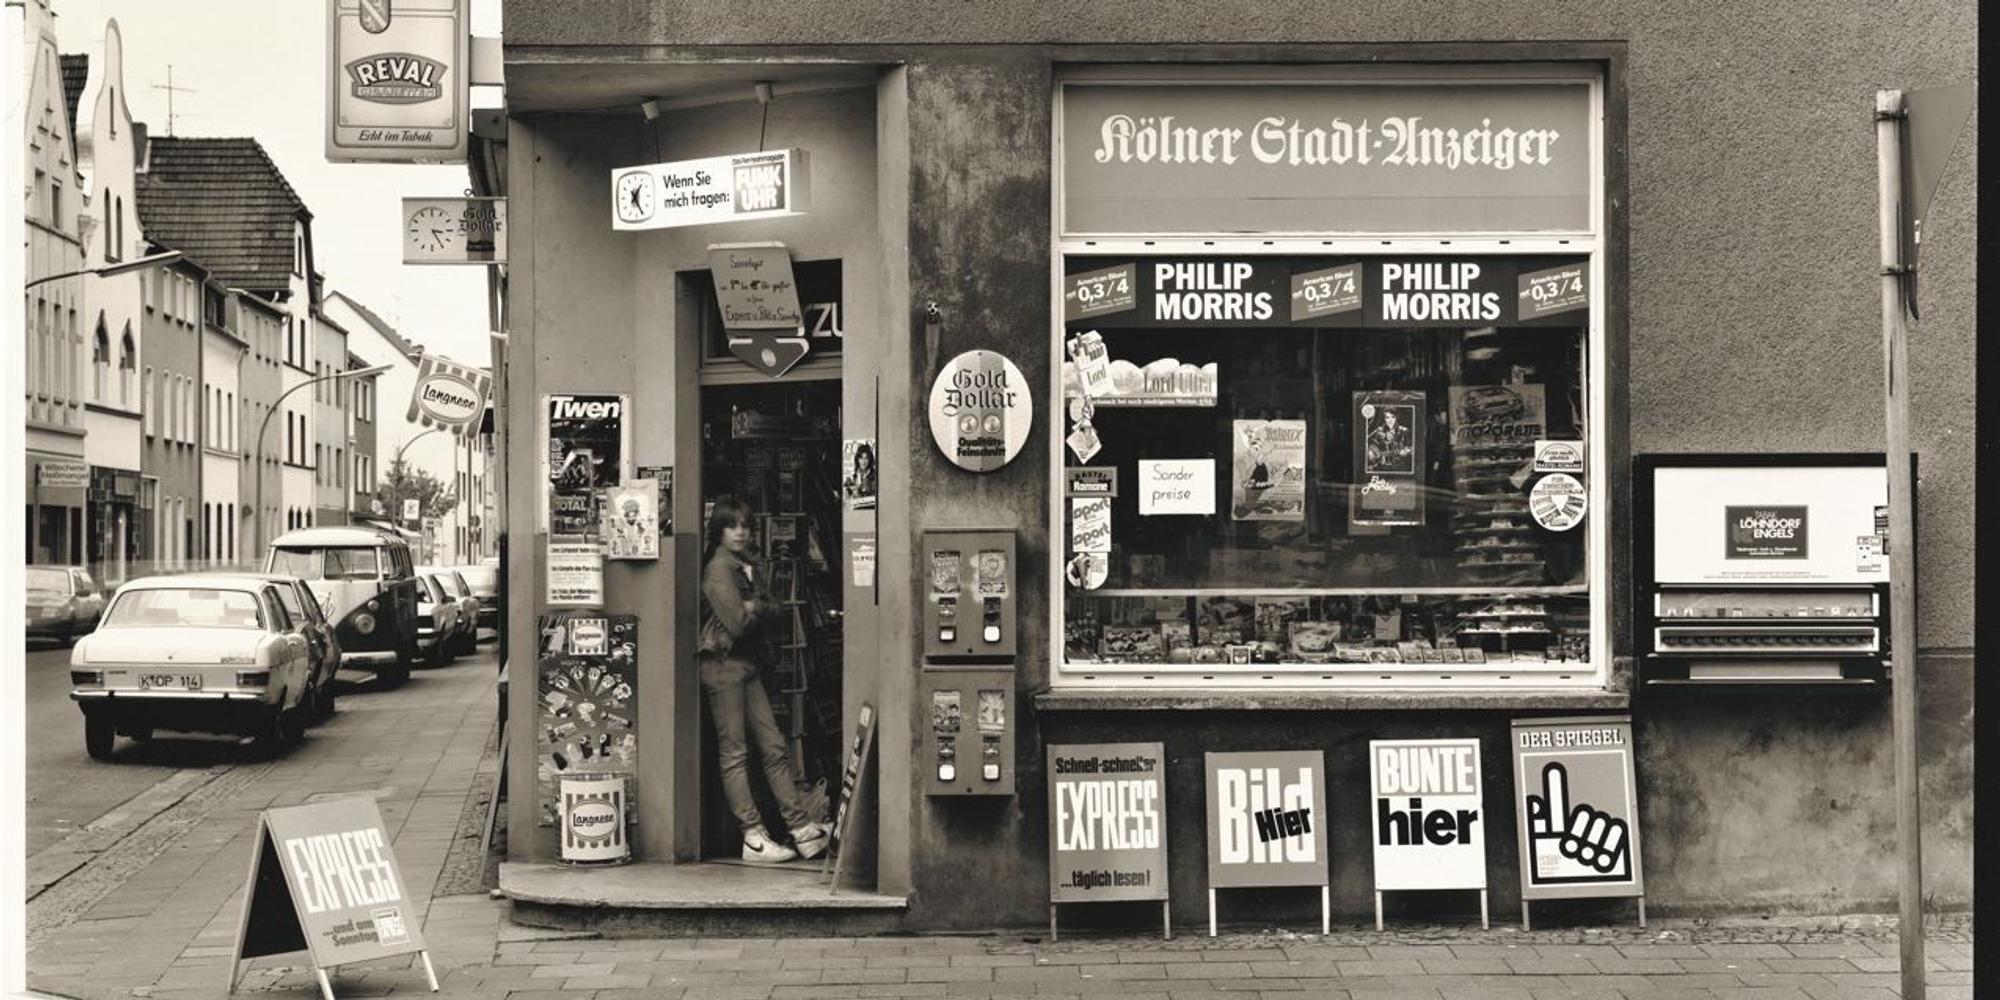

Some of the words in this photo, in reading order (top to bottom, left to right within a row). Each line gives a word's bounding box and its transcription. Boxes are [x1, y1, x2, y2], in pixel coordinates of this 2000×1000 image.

[355, 56, 435, 88] REVAL
[359, 130, 382, 141] Echt
[384, 131, 399, 141] im
[402, 131, 432, 142] Tabak
[1094, 114, 1243, 166] Kölner
[1250, 115, 1561, 170] Stadt-Anzeiger
[663, 174, 694, 189] Wenn
[695, 170, 711, 186] Sie
[736, 165, 782, 190] FUNK
[664, 194, 689, 208] mich
[691, 191, 730, 208] fragen:
[741, 188, 777, 210] UHR
[463, 207, 496, 220] Gold
[457, 219, 501, 236] Dollar
[1155, 263, 1253, 290] PHILIP
[1382, 263, 1480, 290] PHILIP
[1155, 292, 1273, 320] MORRIS
[1382, 292, 1501, 320] MORRIS
[952, 368, 1009, 389] Gold
[1086, 366, 1107, 386] Lord
[1143, 372, 1175, 393] Lord
[1178, 372, 1213, 393] Ultra
[423, 384, 476, 410] Langnese
[550, 396, 620, 419] Twen
[942, 387, 1017, 417] Dollar
[1152, 463, 1194, 482] Sonder
[1151, 489, 1191, 508] preise
[1740, 516, 1801, 529] LÖHNDORF
[1754, 528, 1794, 538] ENGELS
[1520, 732, 1552, 747] DER
[1555, 728, 1624, 747] SPIEGEL
[1379, 747, 1474, 794] BUNTE
[573, 812, 615, 827] Langnese
[1056, 780, 1159, 851] EXPRESS
[1217, 767, 1316, 864] Bild
[1255, 807, 1311, 842] Hier
[1377, 798, 1478, 845] hier
[285, 827, 401, 914] EXPRESS
[356, 920, 374, 930] am
[332, 931, 380, 947] Sonntag
